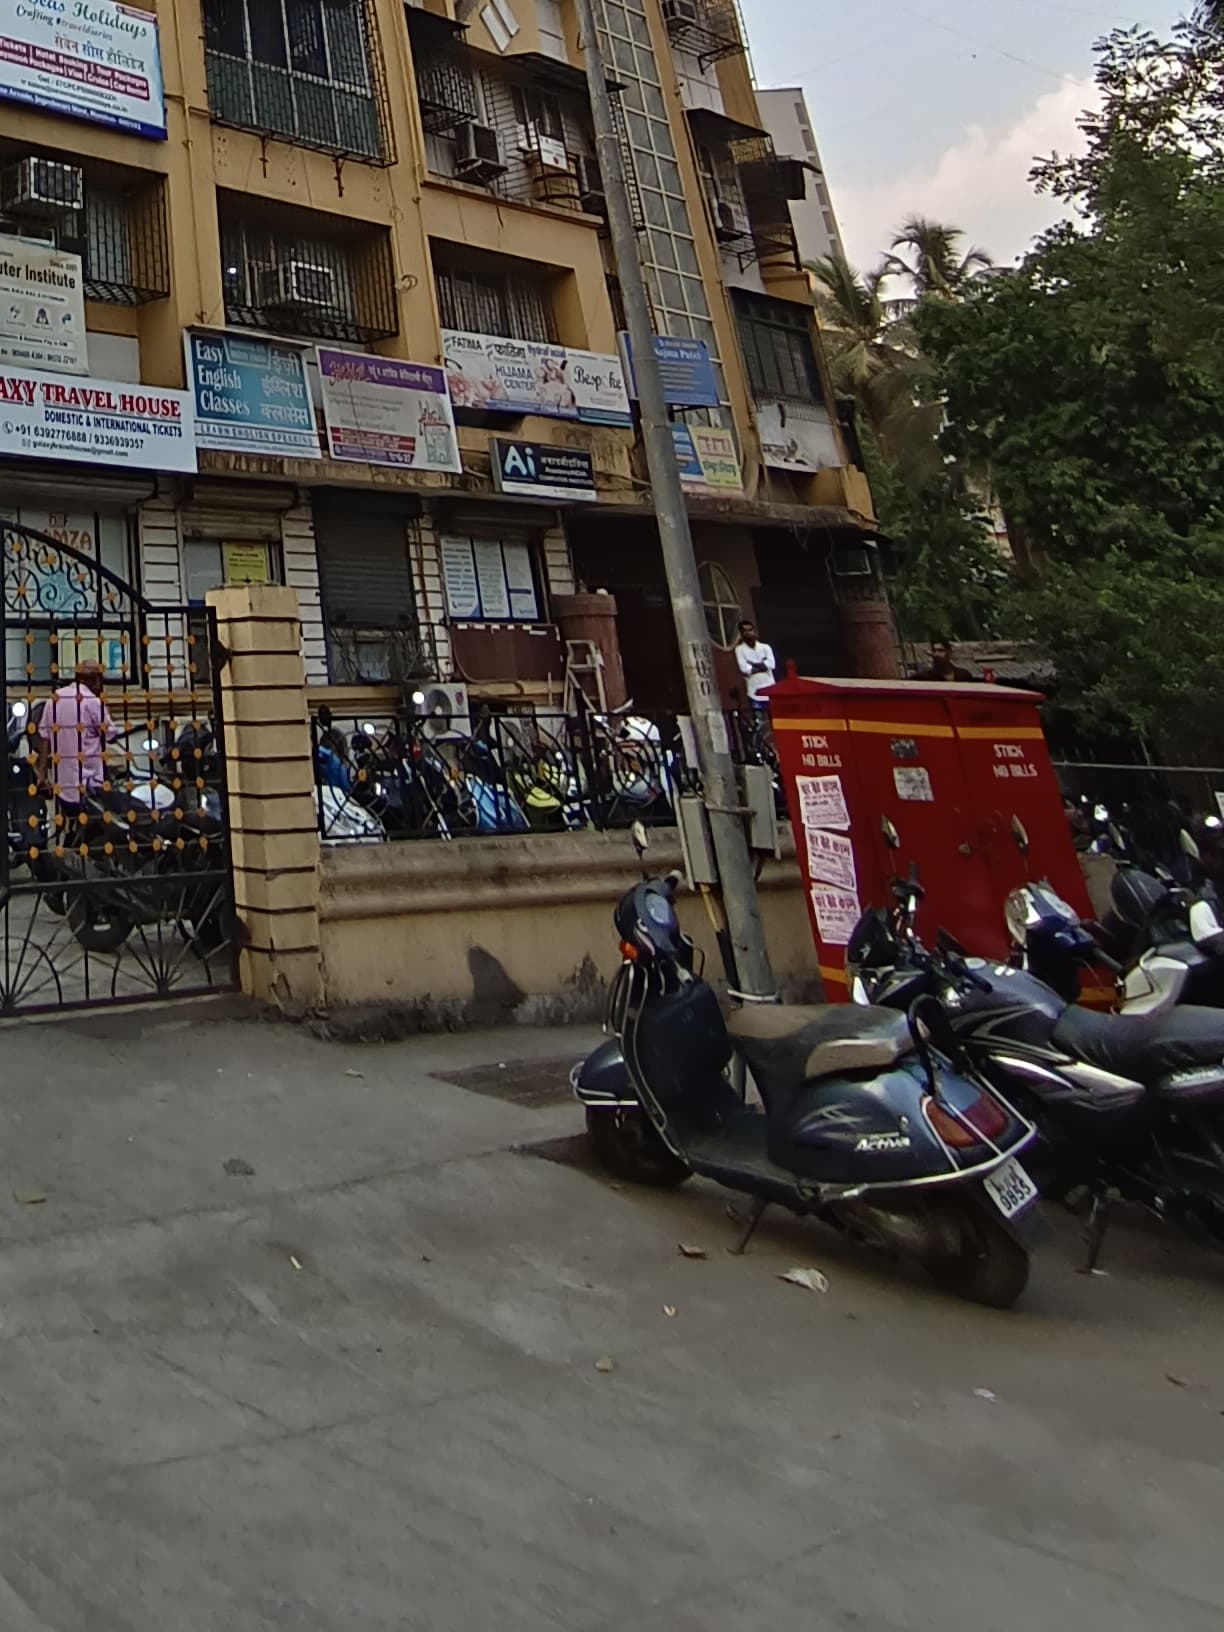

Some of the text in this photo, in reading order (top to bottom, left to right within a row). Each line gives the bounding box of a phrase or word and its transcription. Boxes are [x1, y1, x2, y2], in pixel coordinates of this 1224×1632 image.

[16, 4, 55, 27] Crafting
[72, 1, 148, 40] Holidays
[25, 263, 76, 290] Institute
[195, 340, 224, 369] Easy
[452, 335, 484, 351] FATIMA
[197, 364, 242, 392] English
[494, 364, 535, 381] HIJAMA
[573, 365, 623, 392] Bespke
[503, 378, 537, 392] CENTER
[41, 382, 118, 412] TRAVEL
[119, 393, 182, 418] HOUSE
[200, 390, 251, 417] Classes
[15, 424, 32, 437] +91
[44, 409, 183, 439] DOMESTIC & INTERNATIONAL TICKETS
[503, 444, 536, 479] Ai
[801, 734, 830, 750] STICK
[992, 743, 1025, 760] STICK
[802, 753, 843, 768] NO BILLS
[992, 764, 1039, 779] NO BILLS
[854, 1134, 911, 1152] Activa
